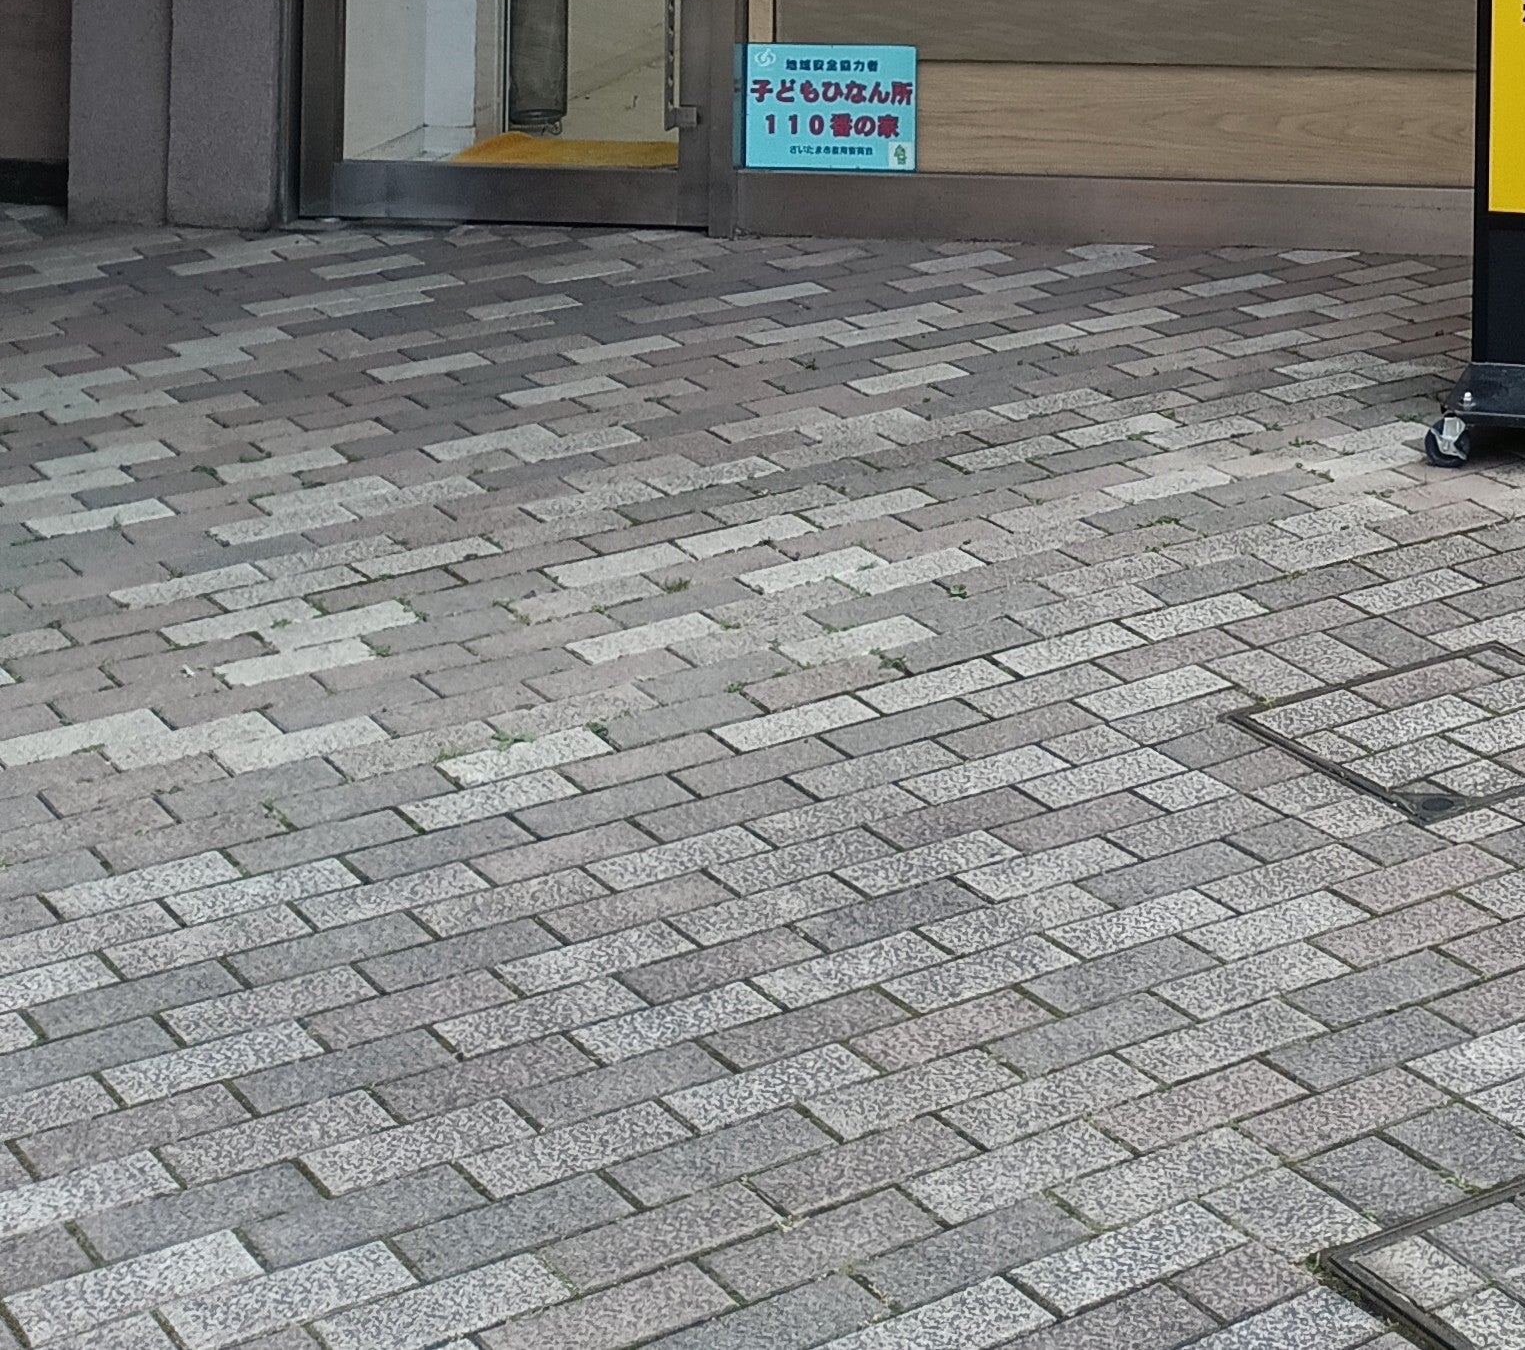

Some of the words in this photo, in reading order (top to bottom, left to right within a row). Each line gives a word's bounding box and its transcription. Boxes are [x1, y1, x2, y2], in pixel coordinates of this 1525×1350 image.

[751, 79, 913, 105] 子どもひなん所
